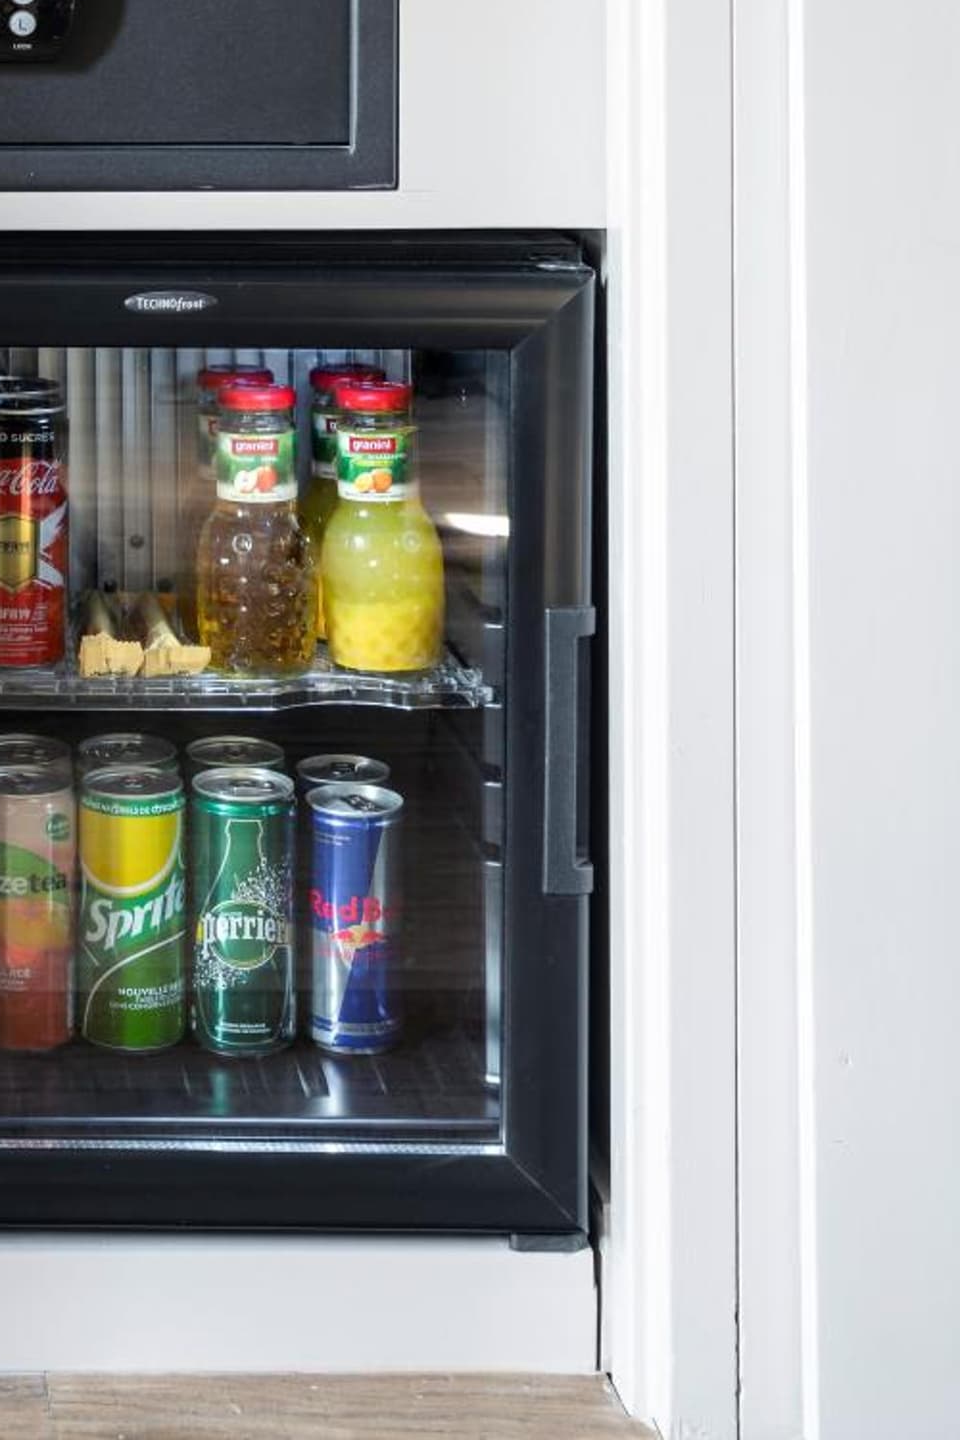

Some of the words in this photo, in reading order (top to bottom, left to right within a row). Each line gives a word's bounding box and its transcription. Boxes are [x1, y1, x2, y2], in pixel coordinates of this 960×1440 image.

[352, 435, 393, 451] granini
[85, 876, 184, 951] Sprite
[308, 887, 358, 922] Red
